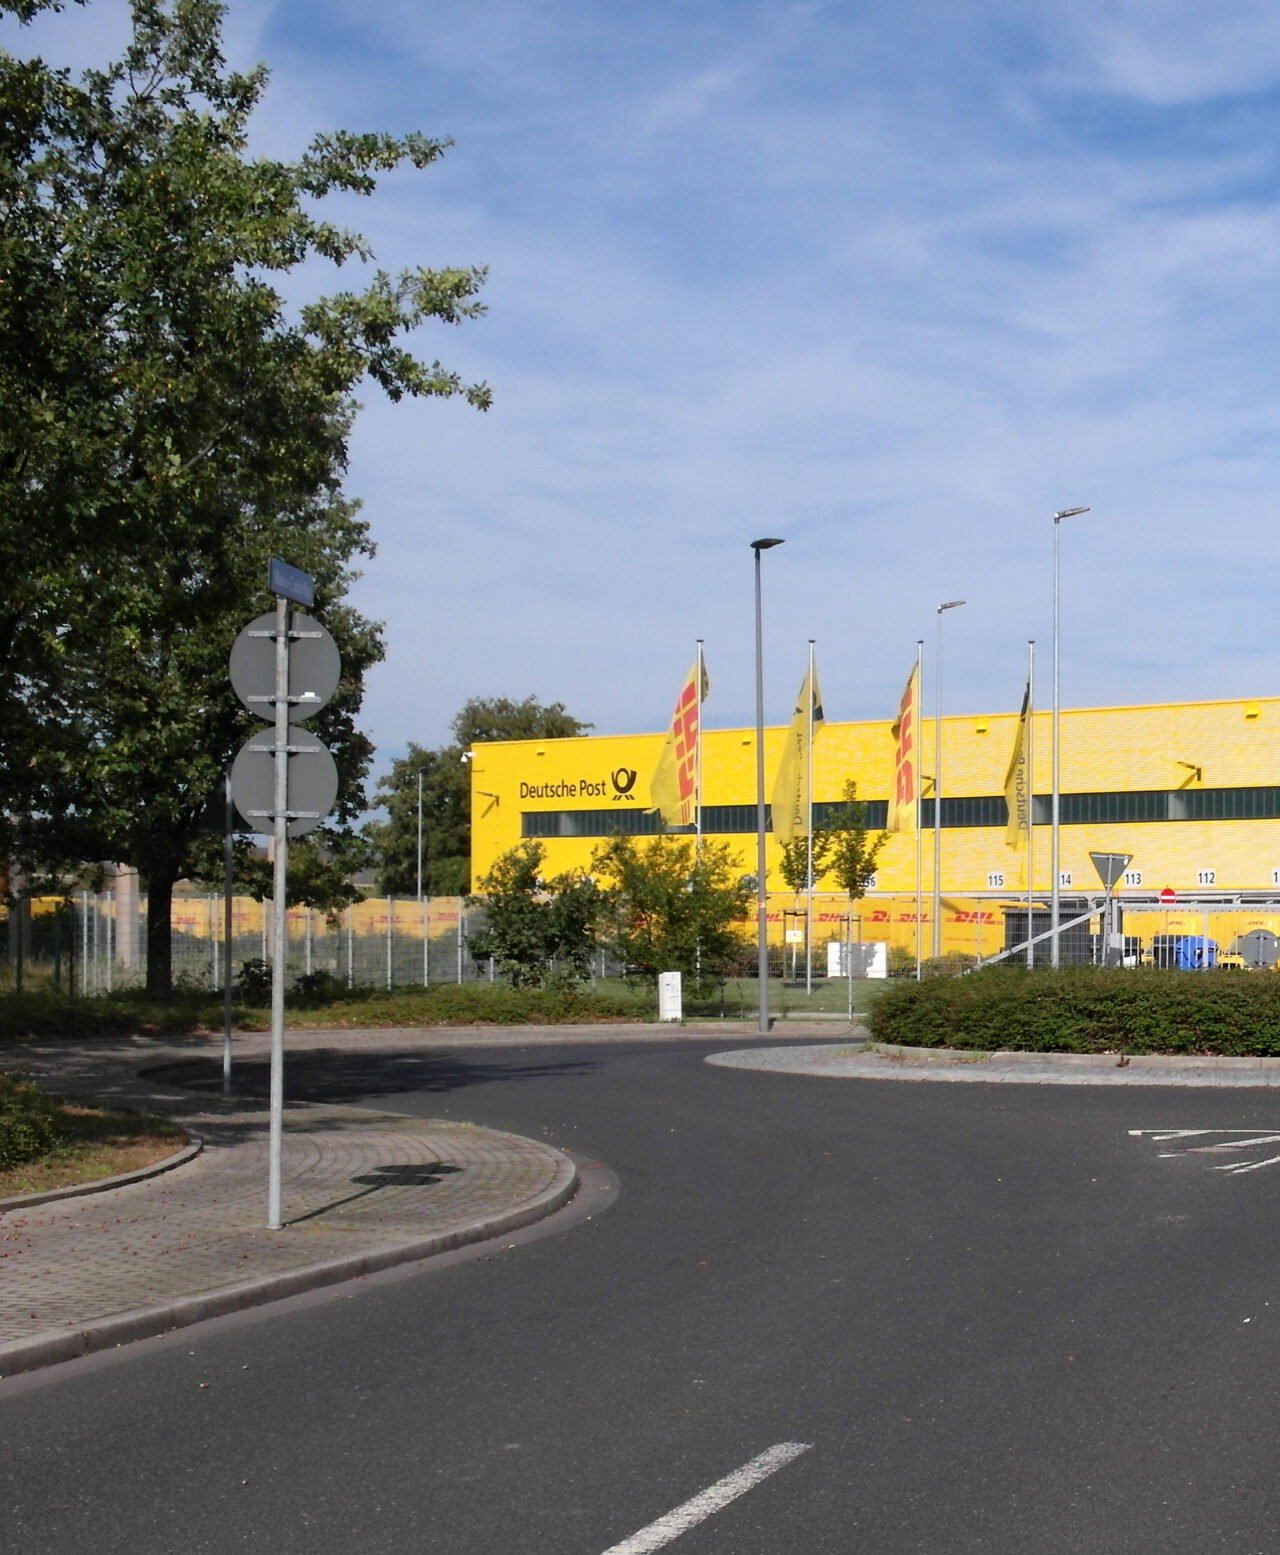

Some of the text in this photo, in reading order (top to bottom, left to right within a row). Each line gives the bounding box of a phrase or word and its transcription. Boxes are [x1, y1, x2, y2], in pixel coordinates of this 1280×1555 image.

[520, 779, 607, 799] Deutsche Post
[988, 875, 1004, 887] 115
[1125, 873, 1142, 885] 113
[1198, 872, 1215, 884] 112
[900, 913, 930, 923] DHL
[955, 911, 996, 925] DHL
